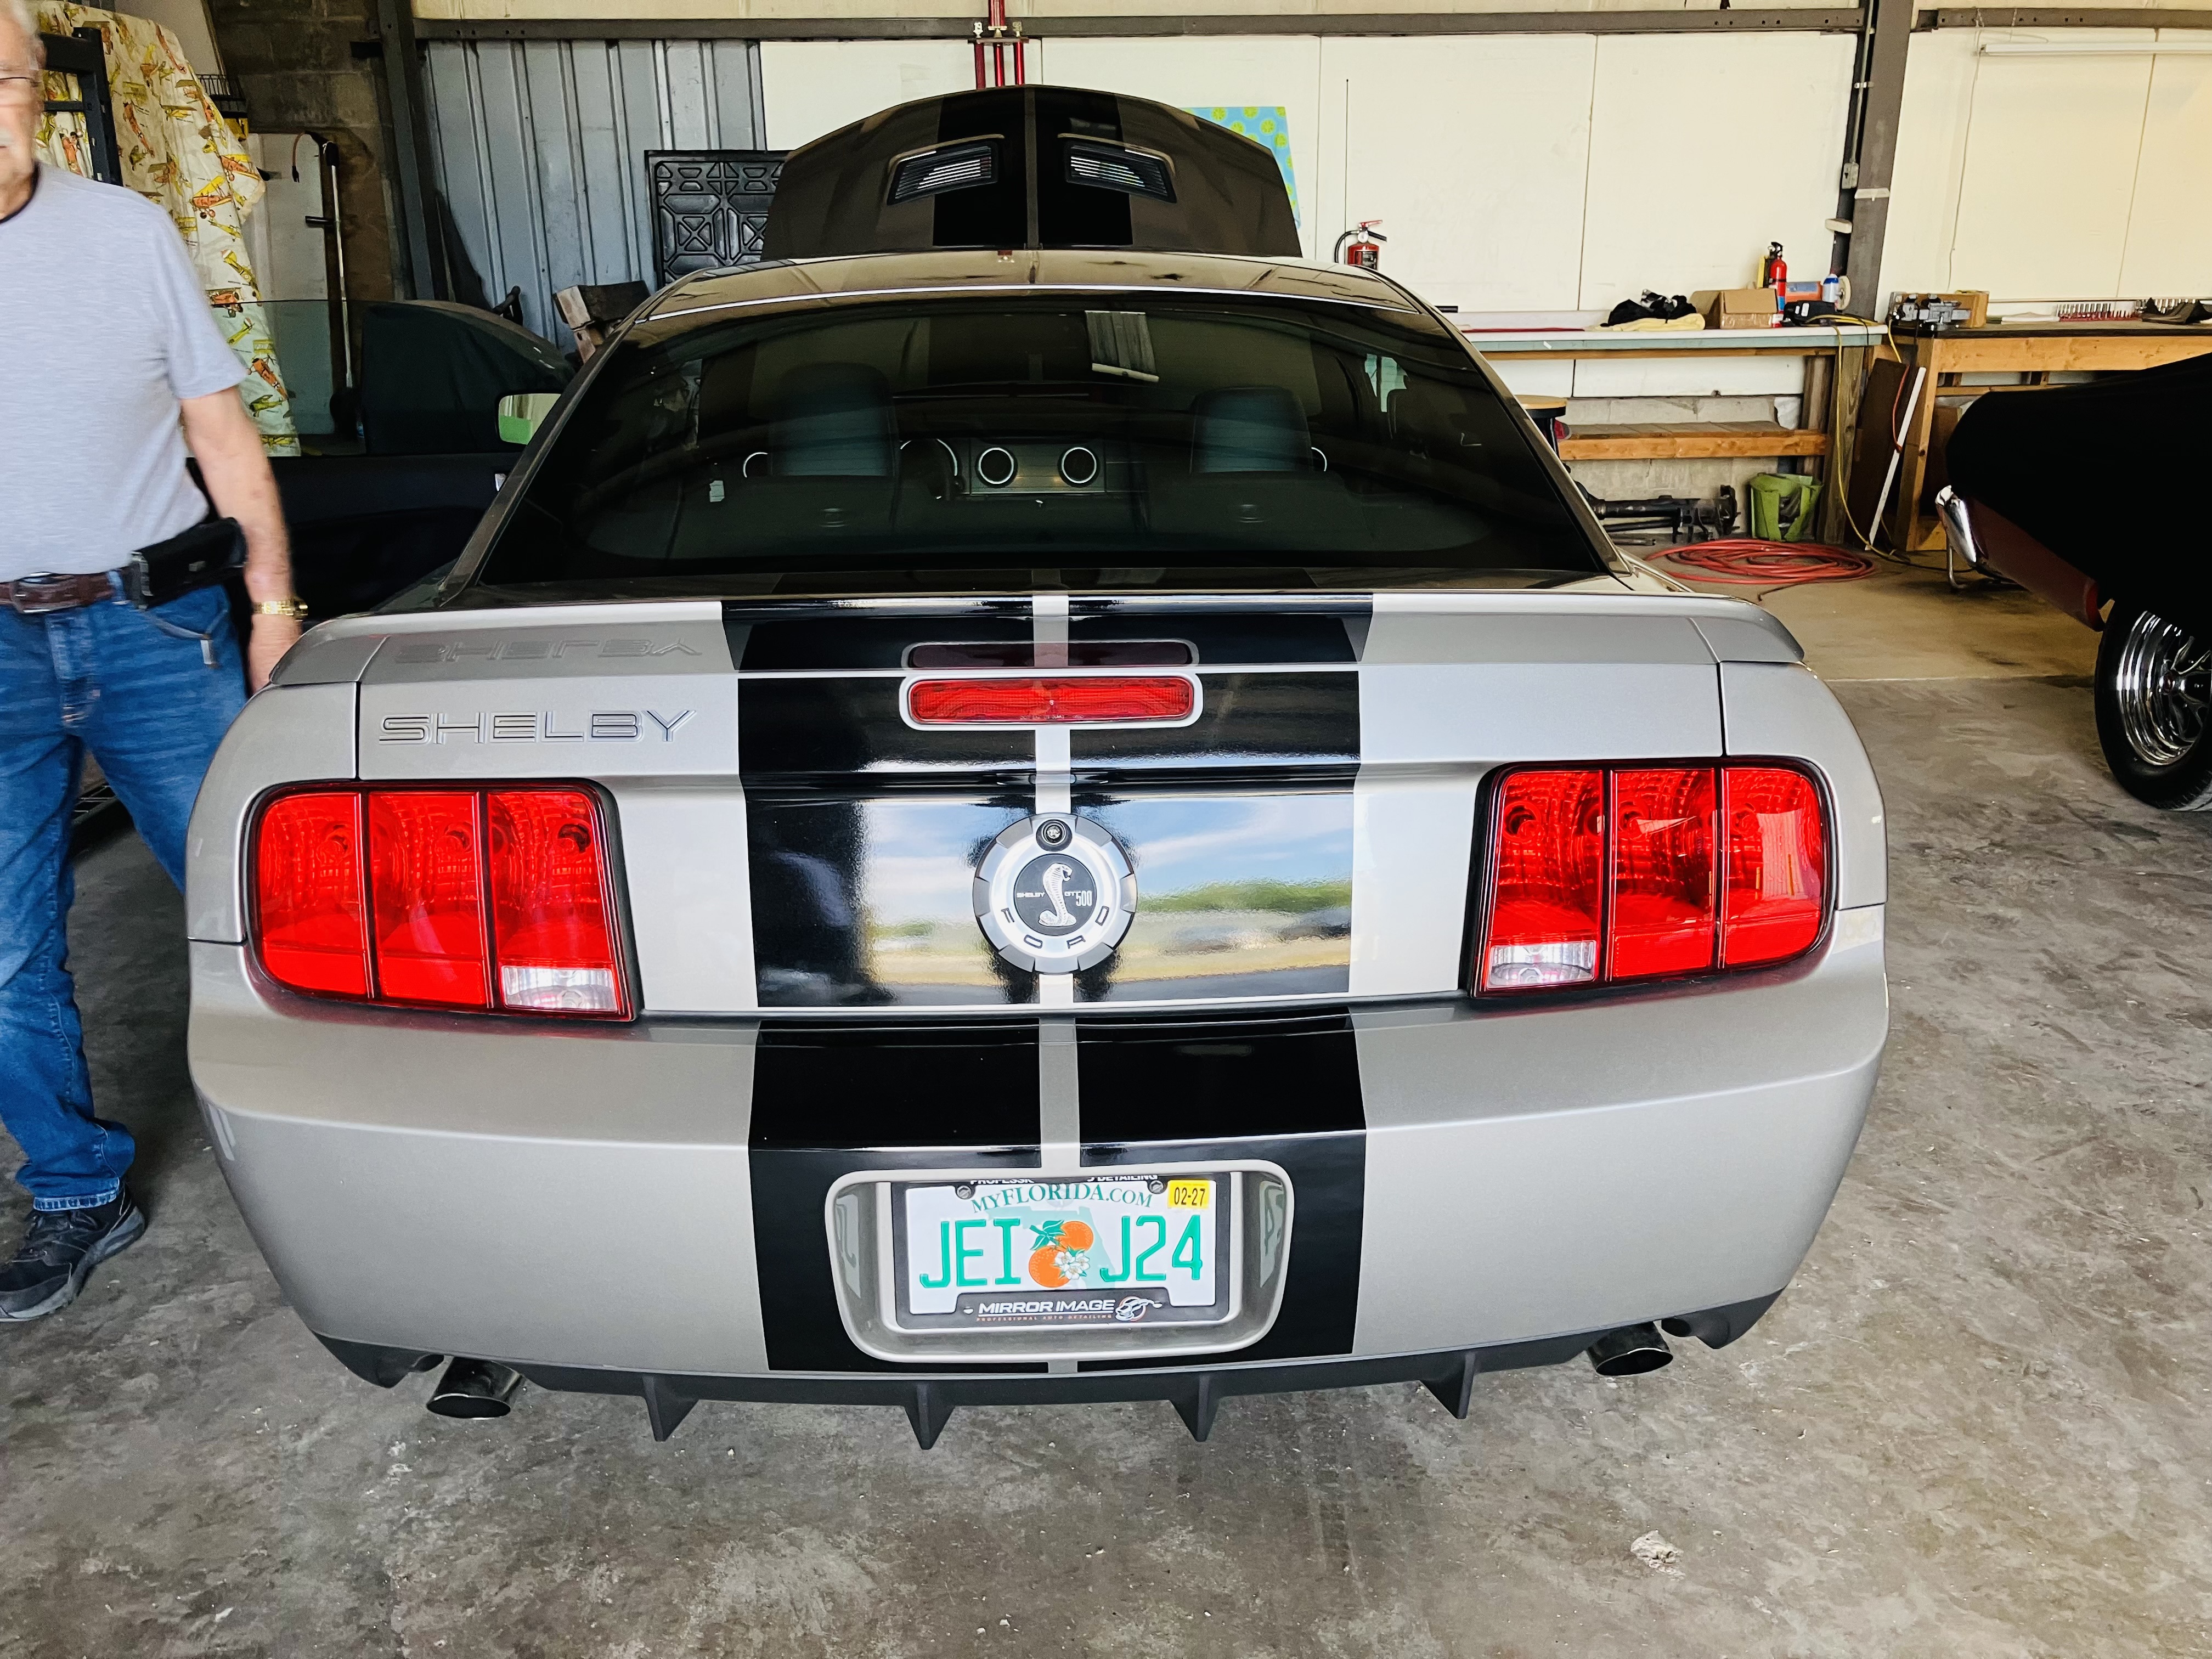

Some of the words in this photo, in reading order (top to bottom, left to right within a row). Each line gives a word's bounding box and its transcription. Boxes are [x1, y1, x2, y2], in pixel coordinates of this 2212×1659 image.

[379, 710, 697, 745] SHELBY
[1001, 905, 1110, 949] FORD
[970, 1183, 1153, 1214] MYFLORIDA.COM
[1174, 1187, 1206, 1206] 02-27
[919, 1217, 1022, 1289] JEI
[1099, 1214, 1203, 1282] J24
[978, 1301, 1053, 1314] MIRROR
[1056, 1300, 1116, 1312] IMAGE
